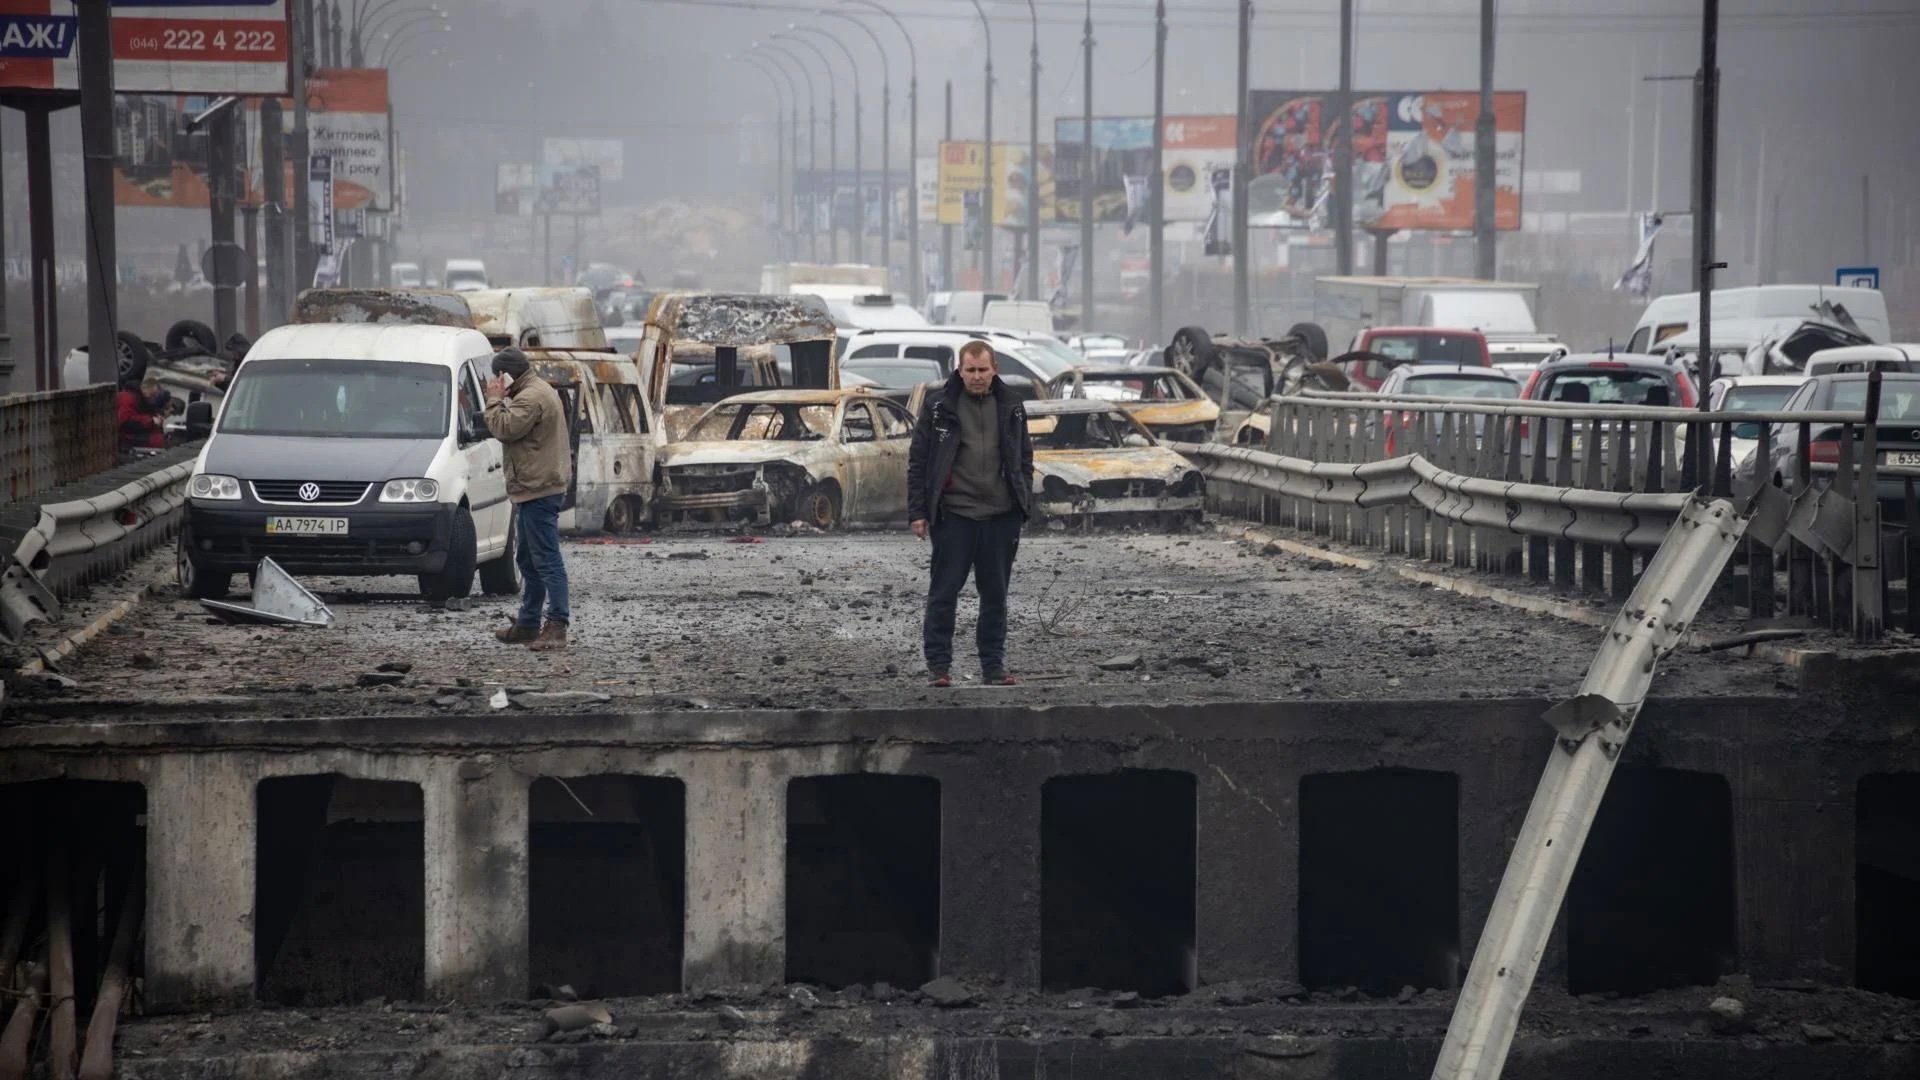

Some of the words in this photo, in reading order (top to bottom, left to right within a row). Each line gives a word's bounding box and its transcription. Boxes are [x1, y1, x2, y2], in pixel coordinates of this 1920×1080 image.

[0, 22, 66, 50] АЖ!
[129, 37, 158, 50] (044)
[163, 29, 206, 50] 222
[212, 30, 226, 50] 4
[233, 31, 276, 51] 222
[313, 127, 382, 141] Житловий
[349, 164, 381, 176] року
[275, 519, 293, 531] AA
[296, 519, 325, 532] 7974
[330, 520, 346, 532] IP
